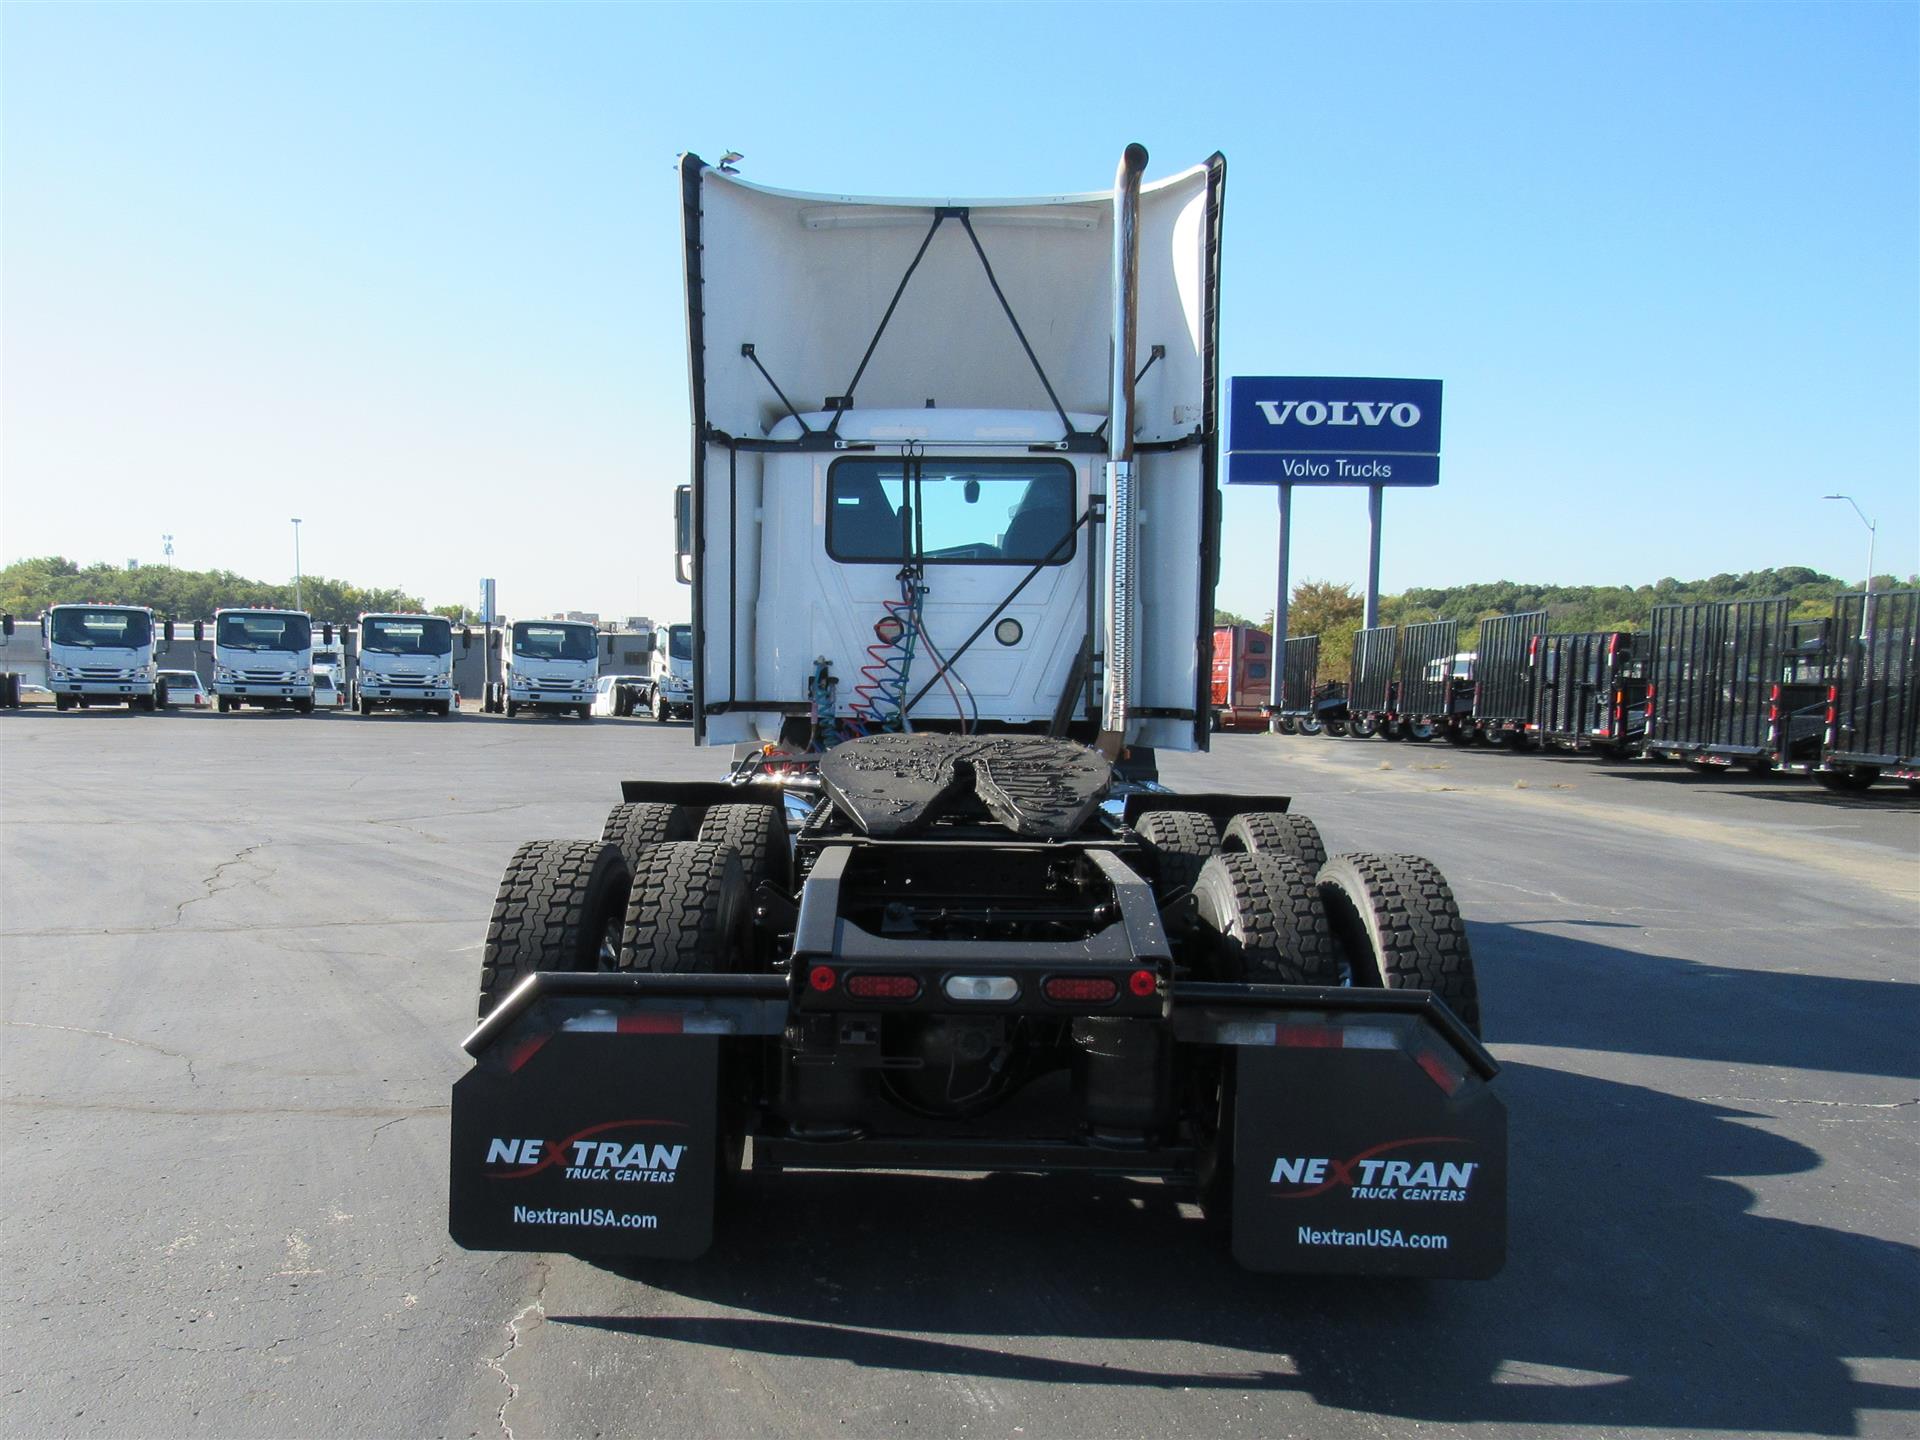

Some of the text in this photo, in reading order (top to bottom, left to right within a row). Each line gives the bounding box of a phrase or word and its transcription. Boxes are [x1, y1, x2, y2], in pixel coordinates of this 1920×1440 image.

[1255, 401, 1421, 428] VOLVO
[1282, 459, 1392, 478] Volvo Trucks
[486, 1137, 687, 1169] NEXTRAN
[565, 1168, 676, 1183] TRUCK CENTERS
[1270, 1157, 1475, 1188] NEXTRAN
[1351, 1187, 1466, 1202] TRUCK CENTERS
[513, 1206, 657, 1228] NextranUSA.com
[1298, 1226, 1448, 1249] NextranUSA.com
